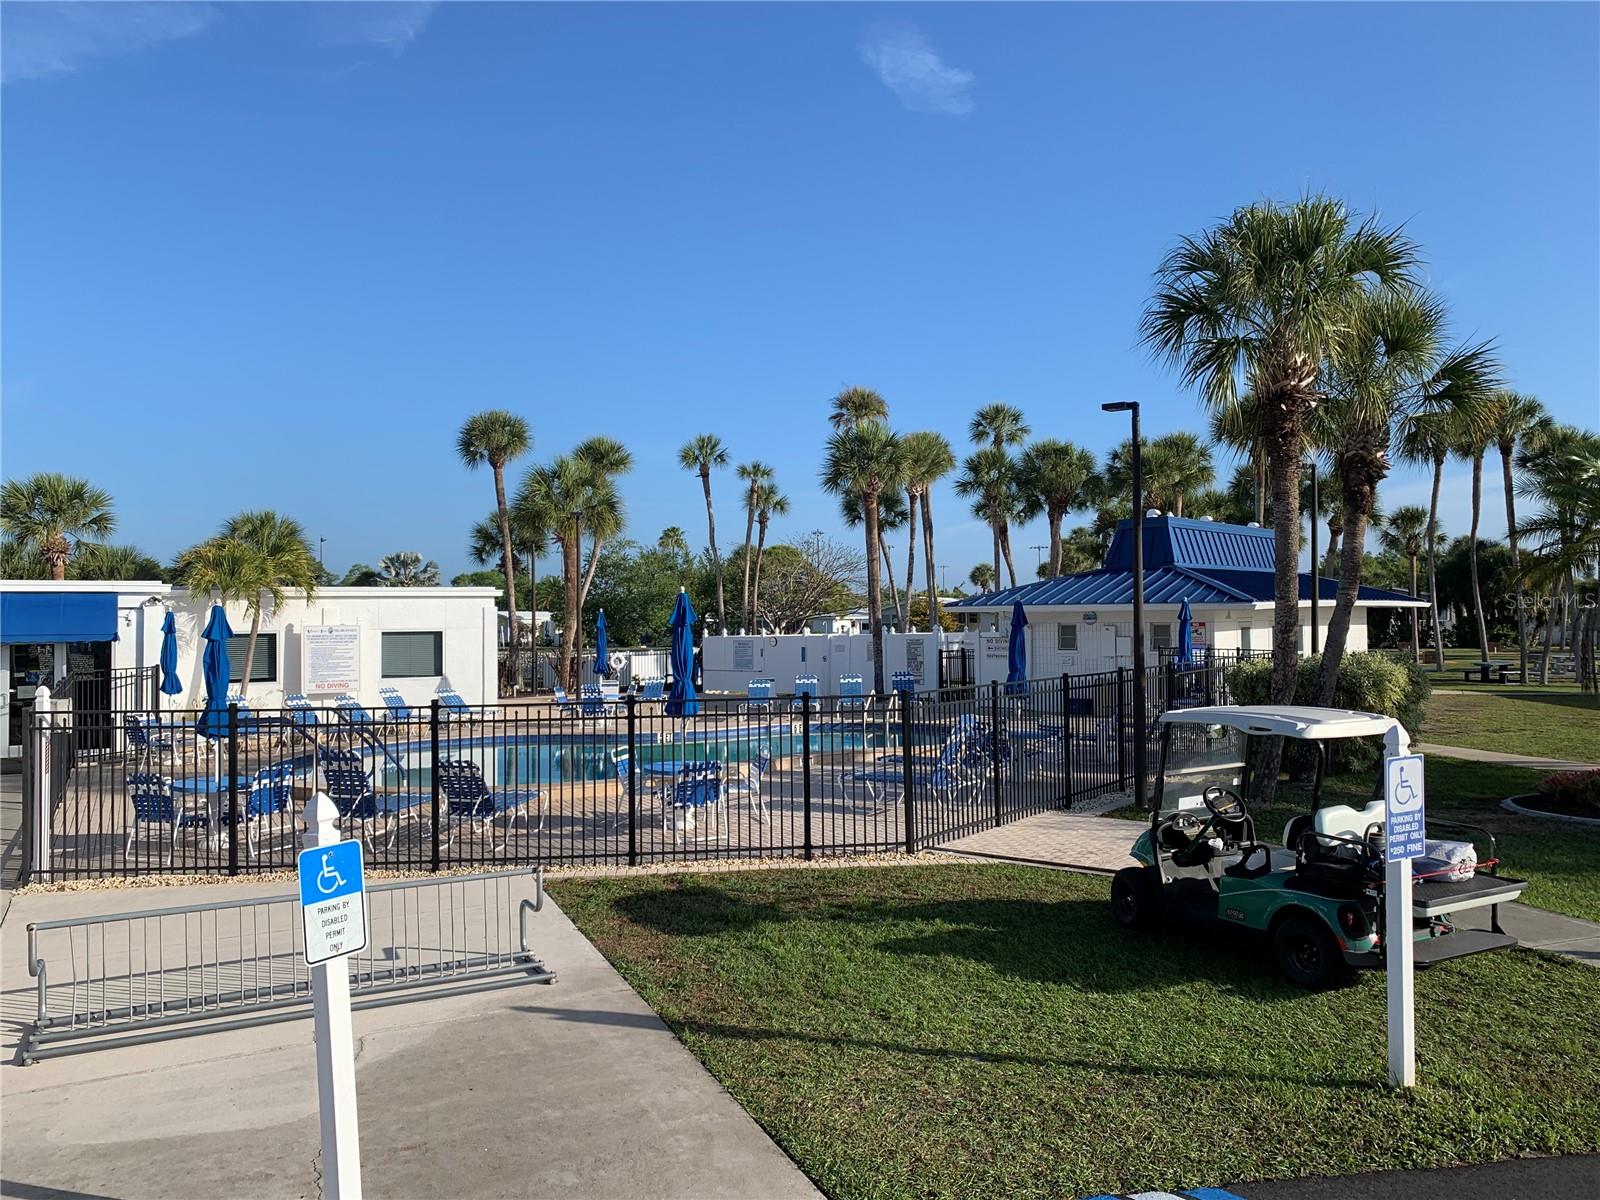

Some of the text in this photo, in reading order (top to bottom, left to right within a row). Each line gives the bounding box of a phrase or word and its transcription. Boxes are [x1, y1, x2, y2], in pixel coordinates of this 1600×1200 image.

[1391, 812, 1422, 824] PARKING BY
[1393, 822, 1419, 833] DISABLED
[1390, 831, 1423, 843] PERMIT ONLY
[1407, 842, 1423, 852] FINE
[317, 900, 350, 916] PARKING BY
[321, 913, 348, 928] DISABLED
[325, 927, 345, 940] PERMIT
[329, 941, 343, 952] ONLY
